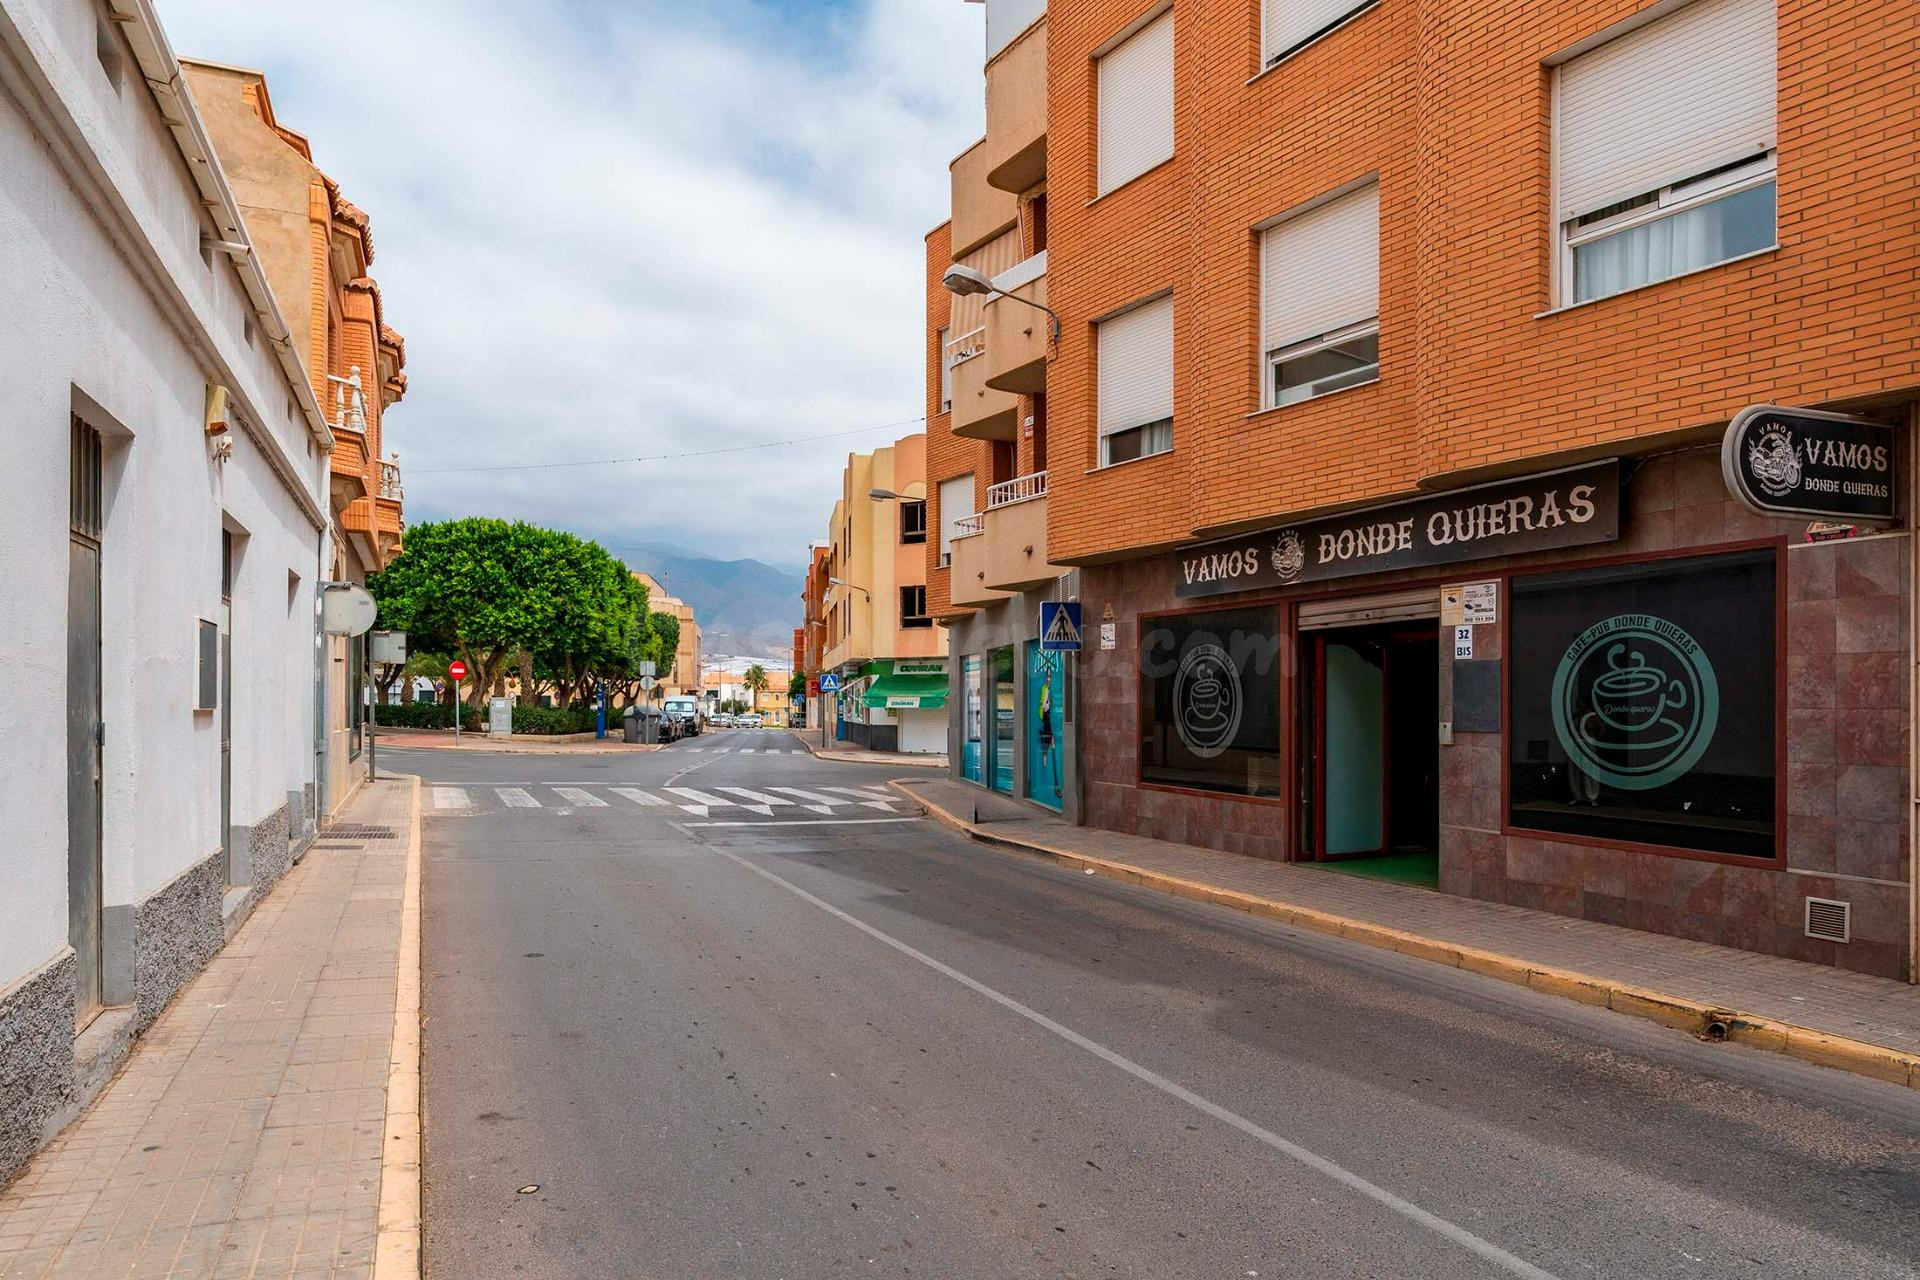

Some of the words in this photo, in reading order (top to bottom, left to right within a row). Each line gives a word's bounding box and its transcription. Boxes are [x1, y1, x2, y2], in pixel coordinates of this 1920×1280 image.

[1804, 437, 1888, 472] VAMOS
[1805, 477, 1840, 493] DONDE
[1843, 481, 1888, 498] QUIERAS
[1182, 547, 1259, 586] VAMOS
[1318, 517, 1415, 564] DONDE
[1426, 484, 1597, 546] QUIERAS
[1457, 629, 1470, 640] 32
[1615, 615, 1650, 628] DONDE
[1654, 620, 1698, 655] QUIERAS
[1456, 646, 1472, 656] BIS
